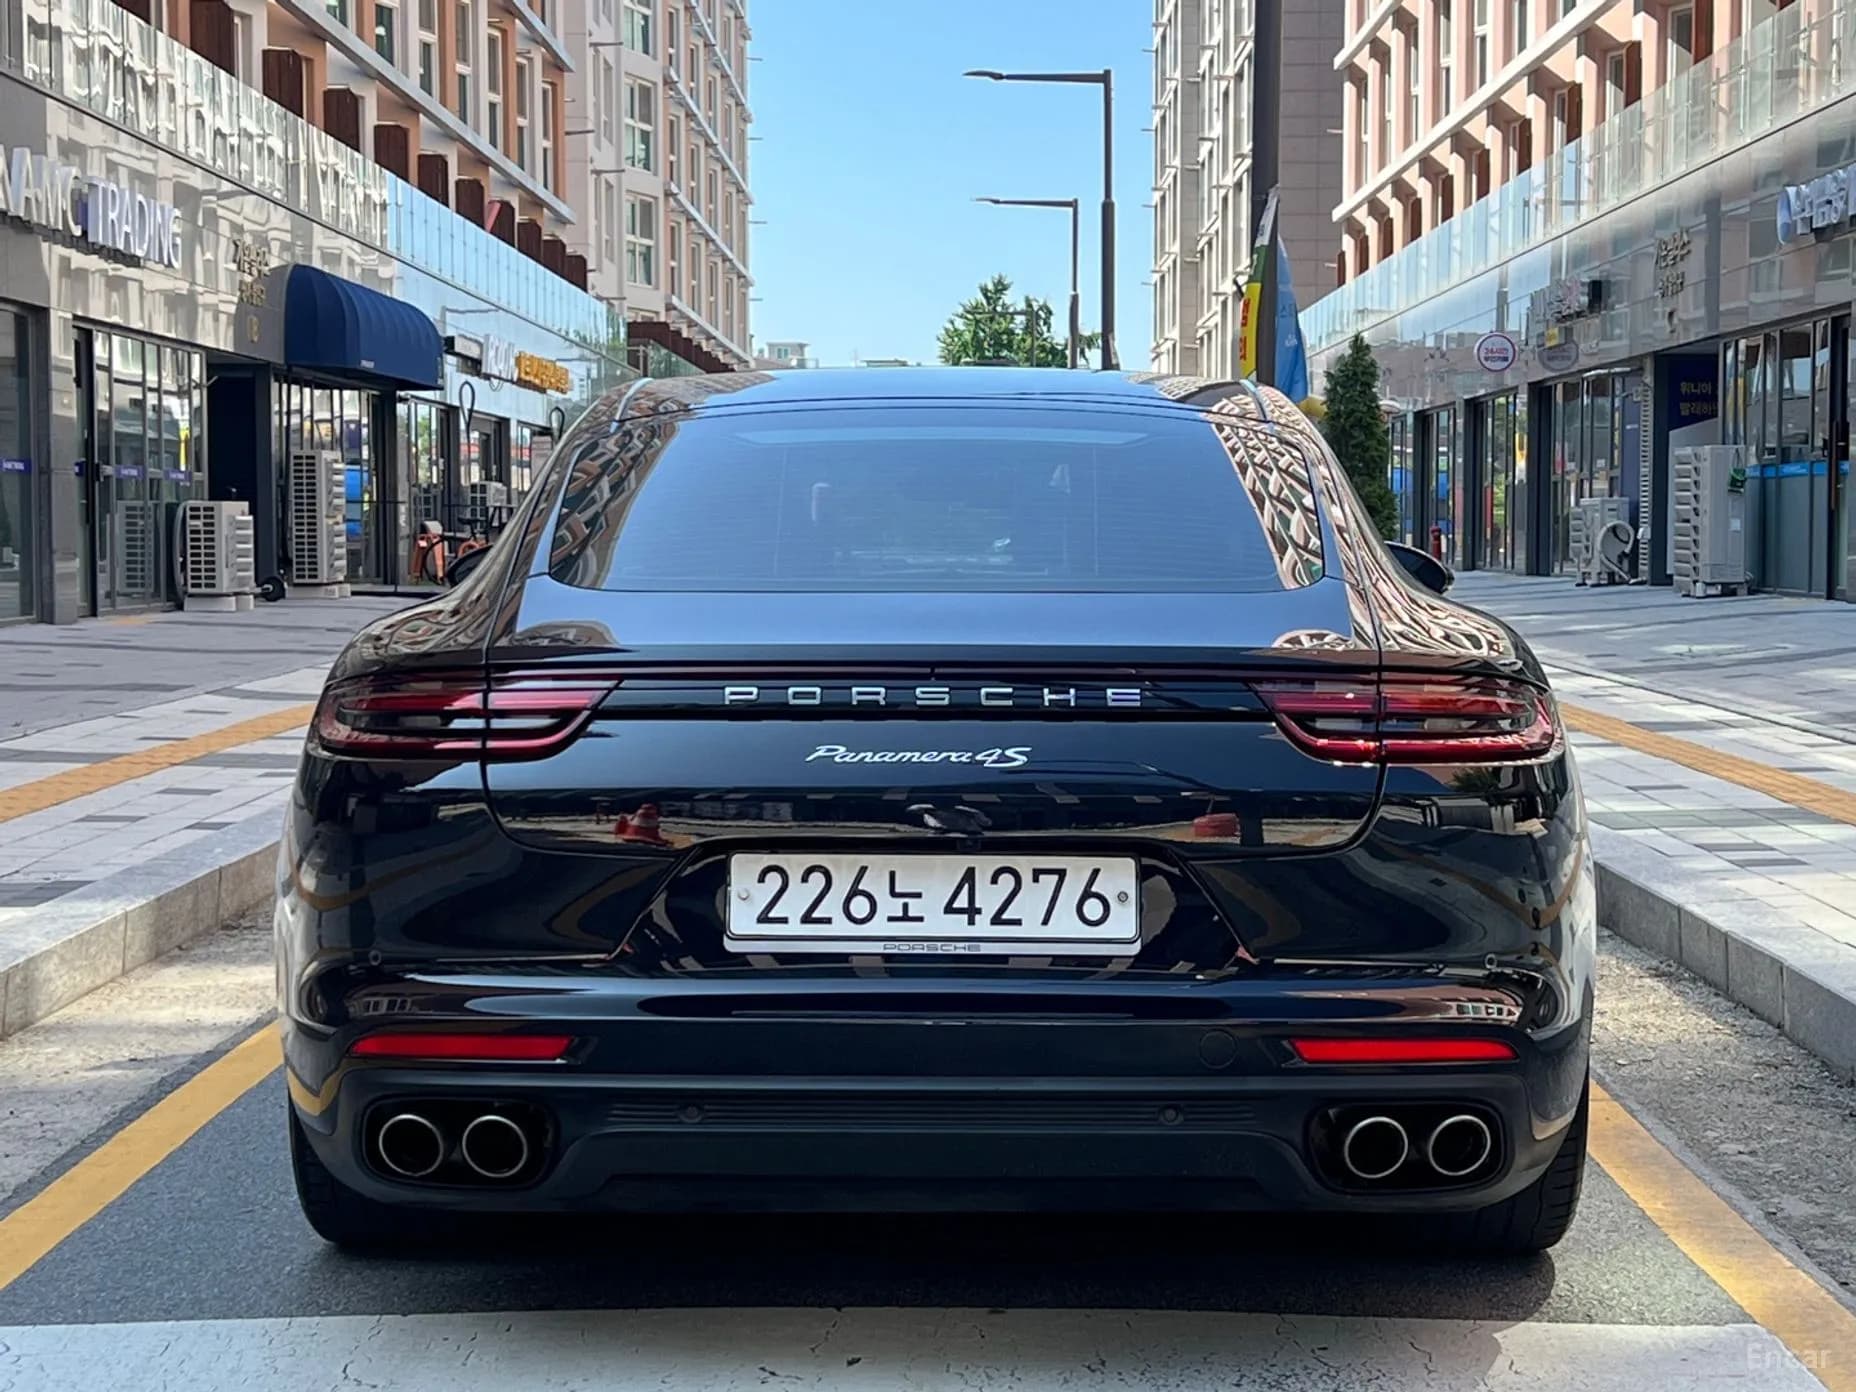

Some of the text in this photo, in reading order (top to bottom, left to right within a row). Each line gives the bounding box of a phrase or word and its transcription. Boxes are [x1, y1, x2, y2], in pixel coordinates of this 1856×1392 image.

[88, 177, 182, 269] TRADING
[724, 686, 1142, 706] PORSCHE
[805, 744, 1032, 768] Panamera 4S
[883, 943, 981, 953] PORSCHE
